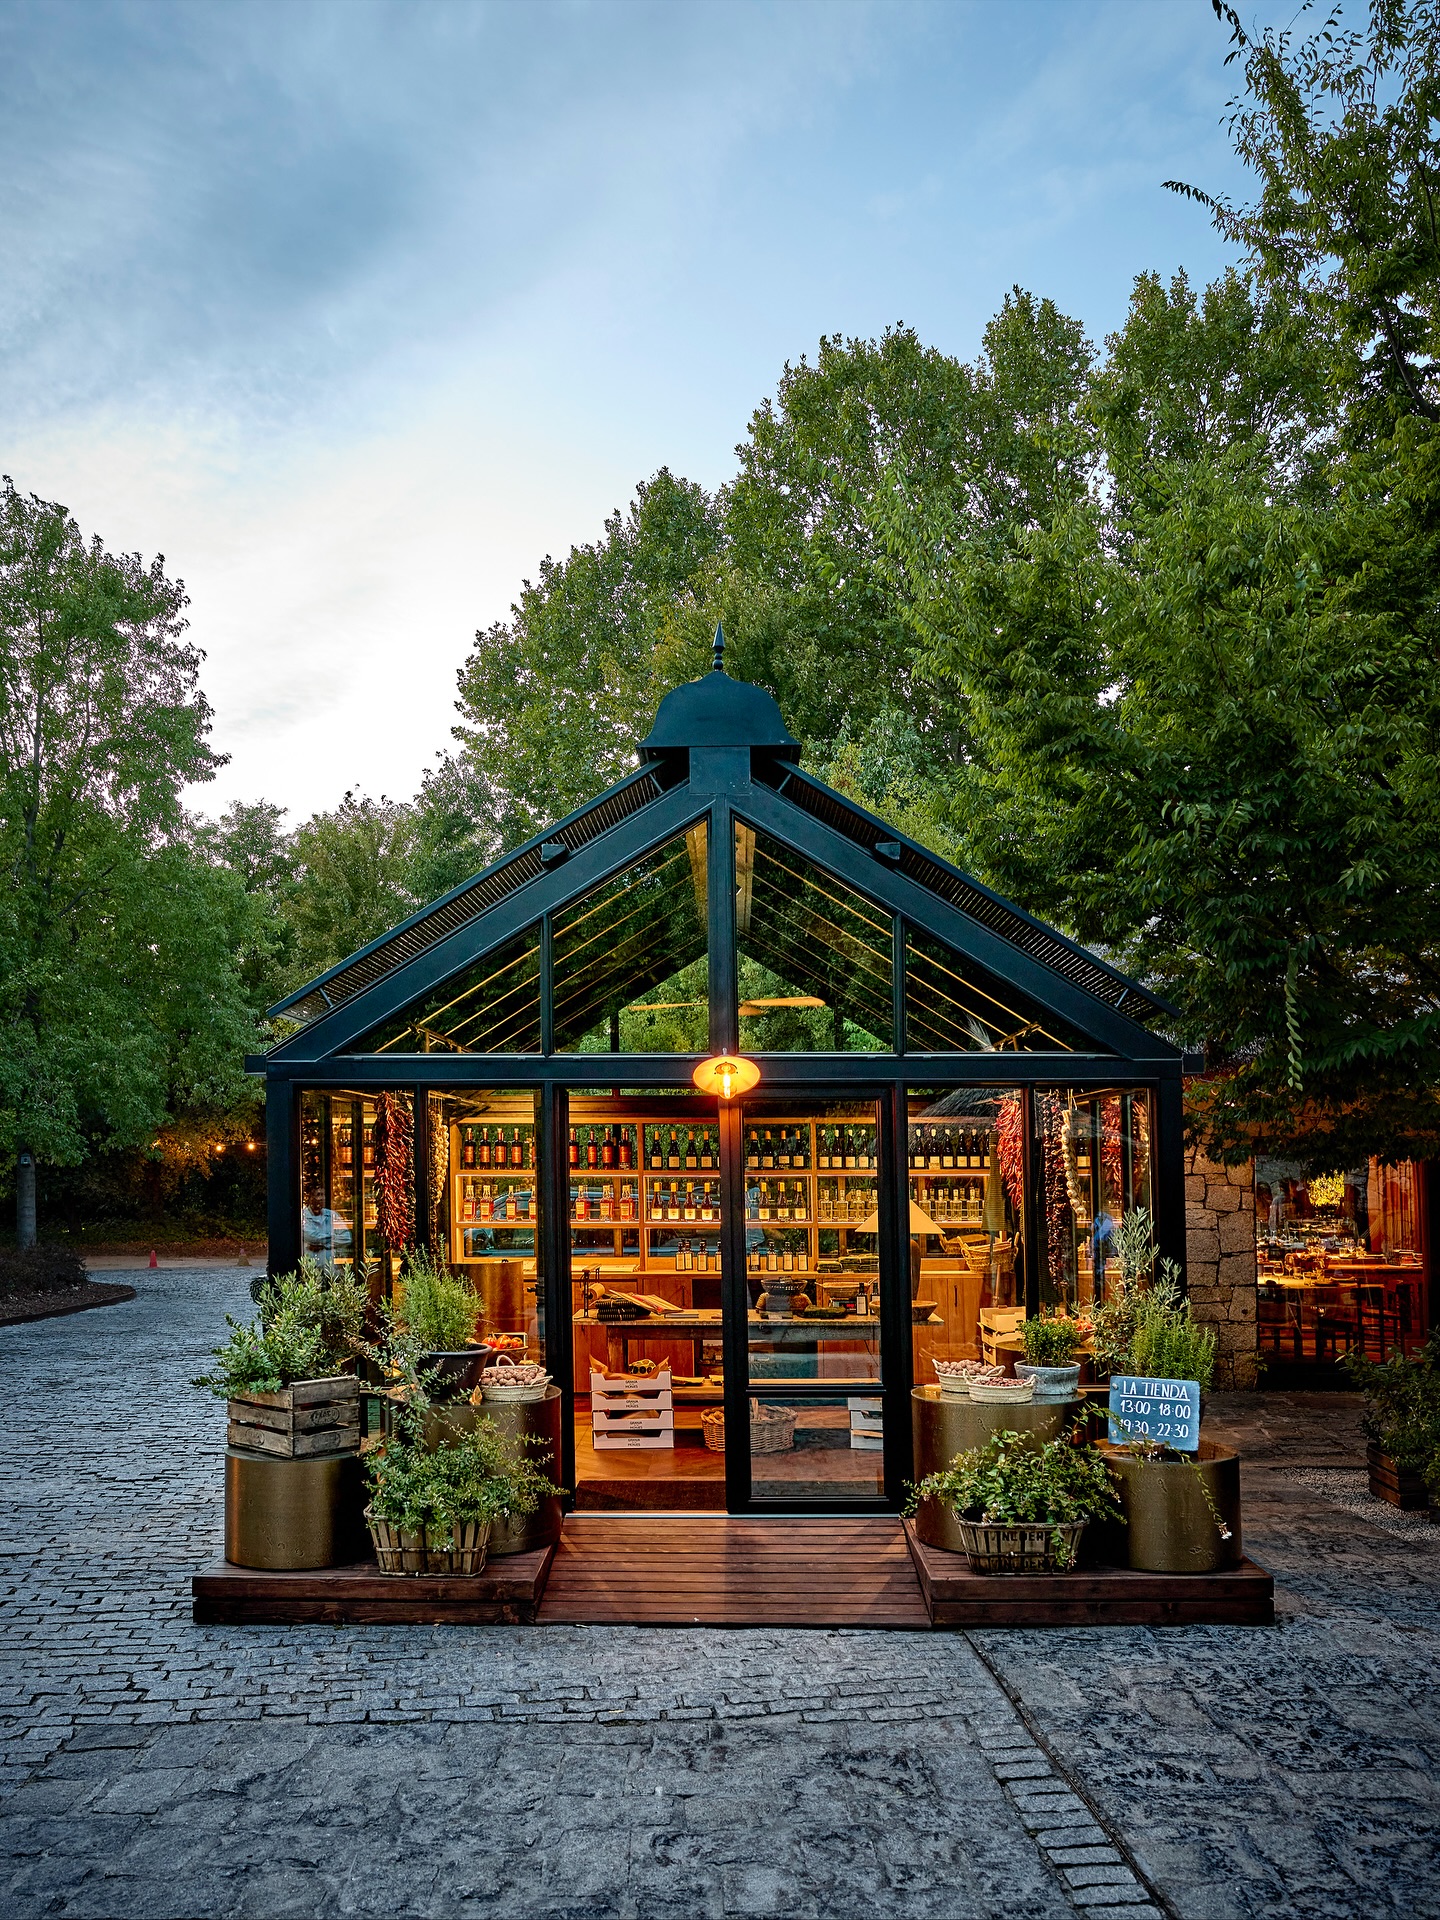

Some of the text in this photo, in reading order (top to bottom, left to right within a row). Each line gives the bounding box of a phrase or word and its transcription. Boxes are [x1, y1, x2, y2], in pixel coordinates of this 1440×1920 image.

[1124, 1380, 1188, 1399] LA TIENDA
[1120, 1400, 1150, 1414] 13:00
[1158, 1403, 1190, 1419] 18:00
[1156, 1422, 1188, 1438] 22:30
